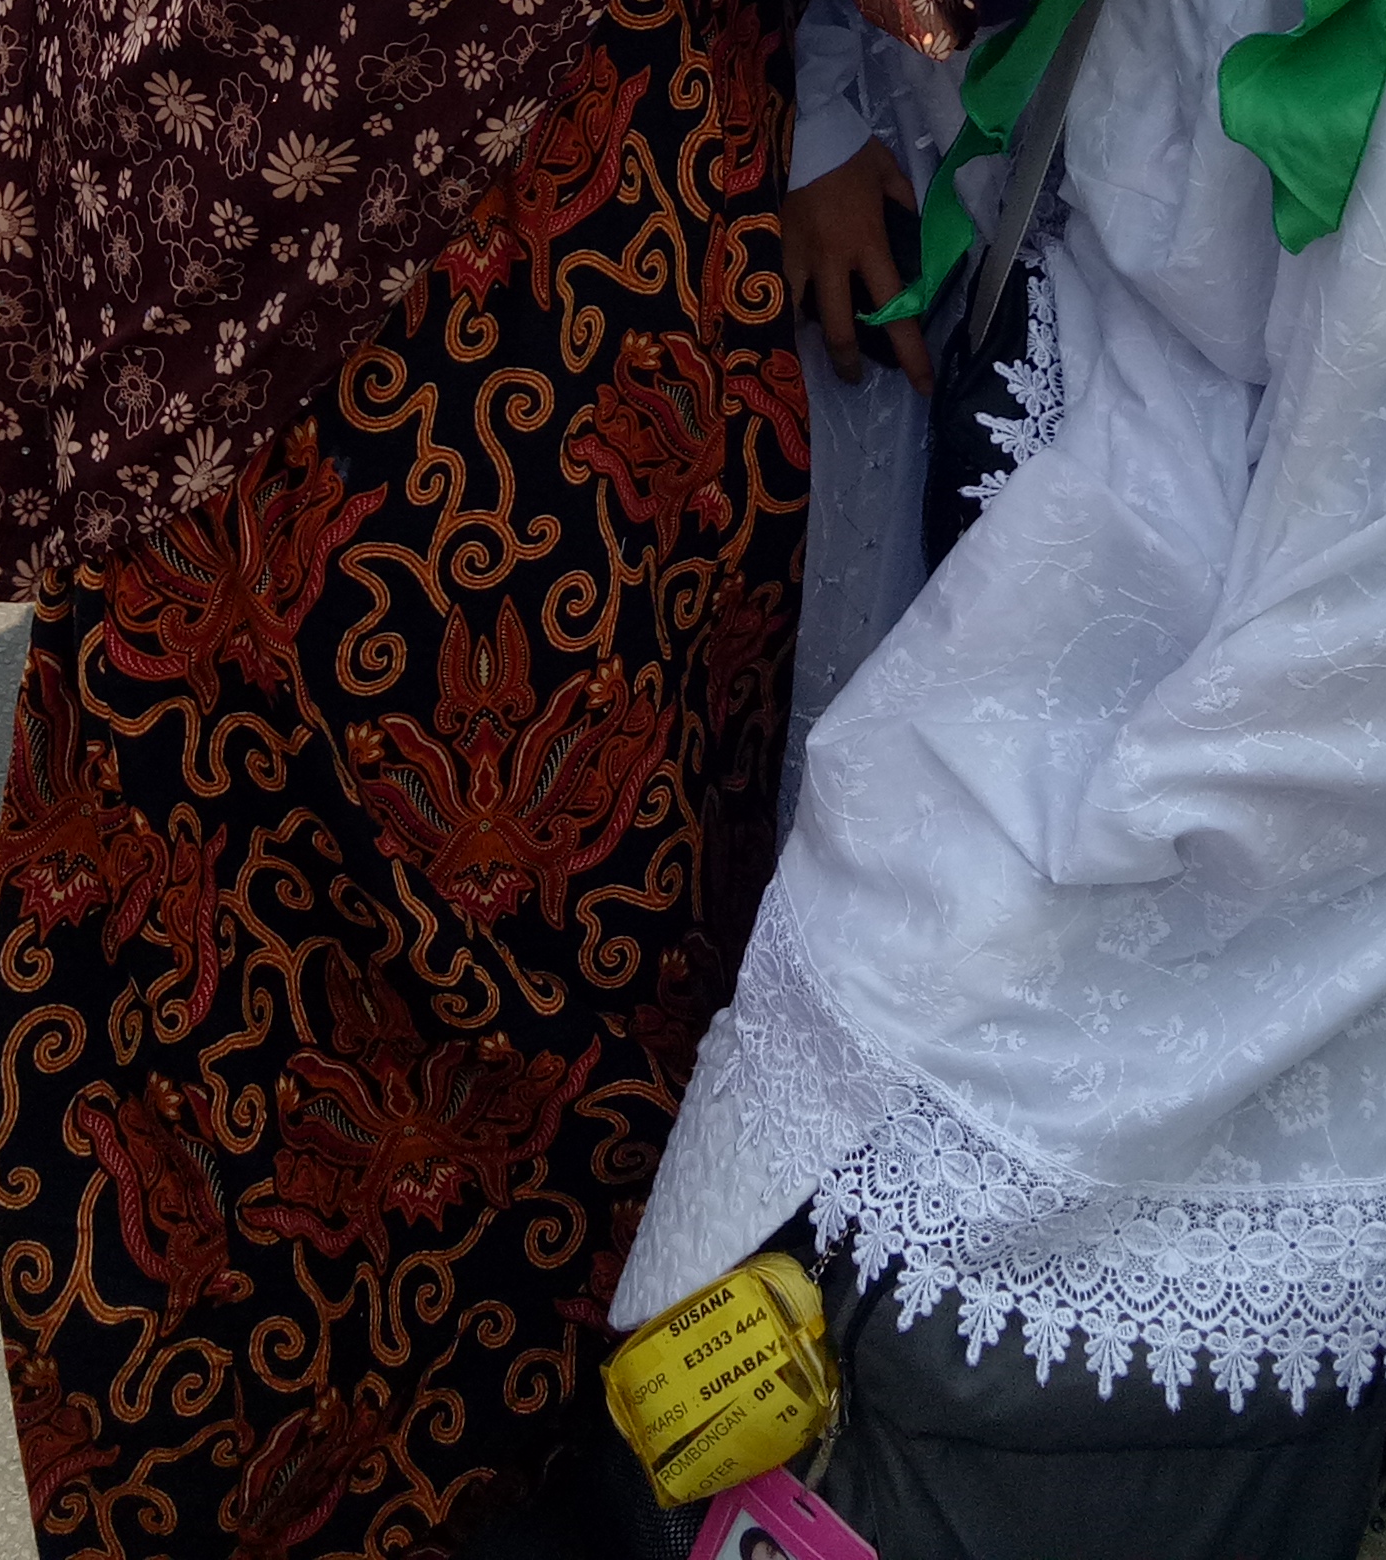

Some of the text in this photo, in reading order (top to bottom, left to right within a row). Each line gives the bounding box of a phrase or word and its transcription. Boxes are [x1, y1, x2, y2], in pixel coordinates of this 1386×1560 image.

[669, 1287, 735, 1337] SUSANA
[659, 1405, 748, 1485] ROMBONGAN
[754, 1379, 775, 1401] 08
